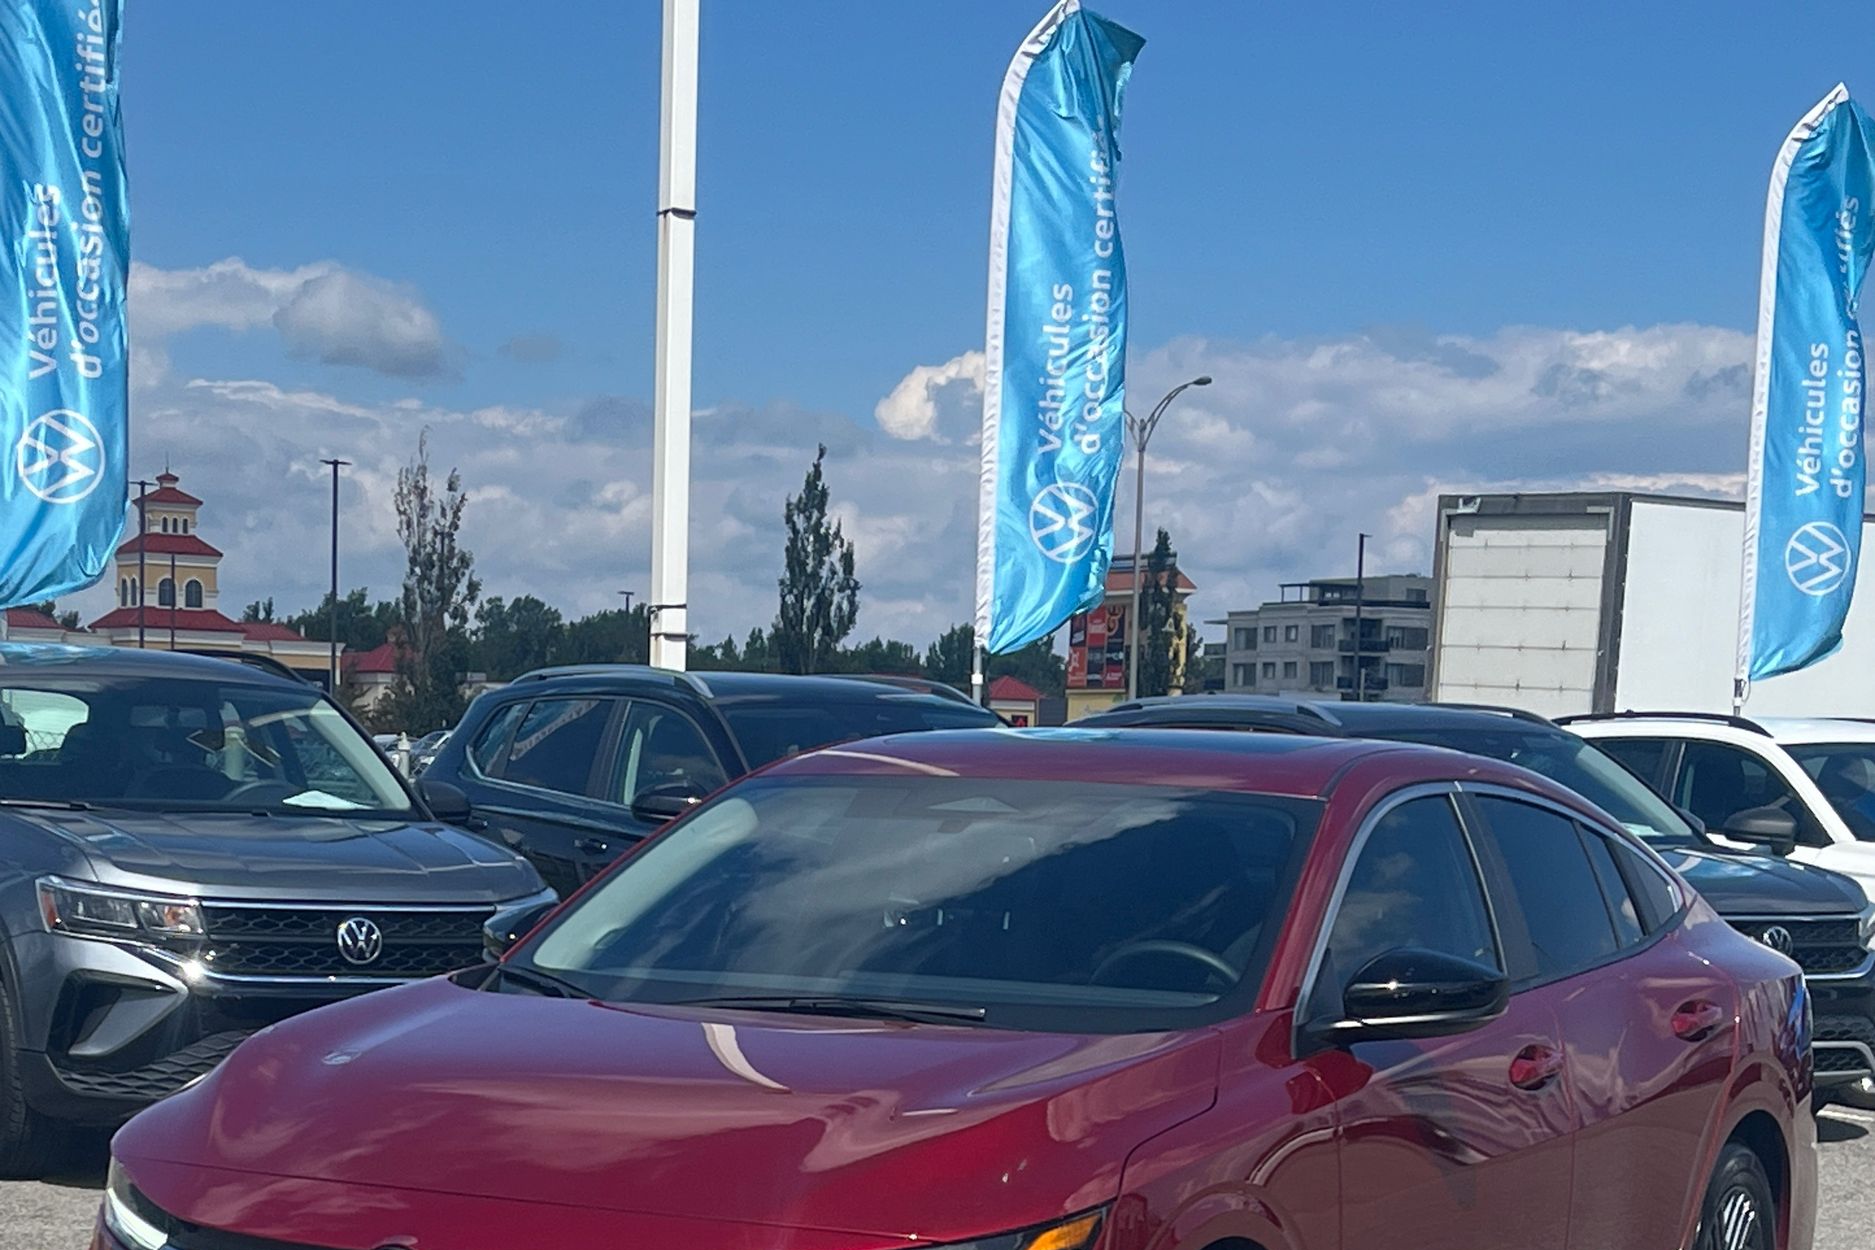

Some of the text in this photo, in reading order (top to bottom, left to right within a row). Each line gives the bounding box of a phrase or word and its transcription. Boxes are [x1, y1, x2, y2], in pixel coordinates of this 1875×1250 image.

[26, 183, 61, 380] Véhicules
[70, 171, 104, 378] d'occasion
[1036, 283, 1073, 453] Véhicules
[1795, 341, 1829, 497] Véhicules
[1829, 329, 1863, 499] d'occasion
